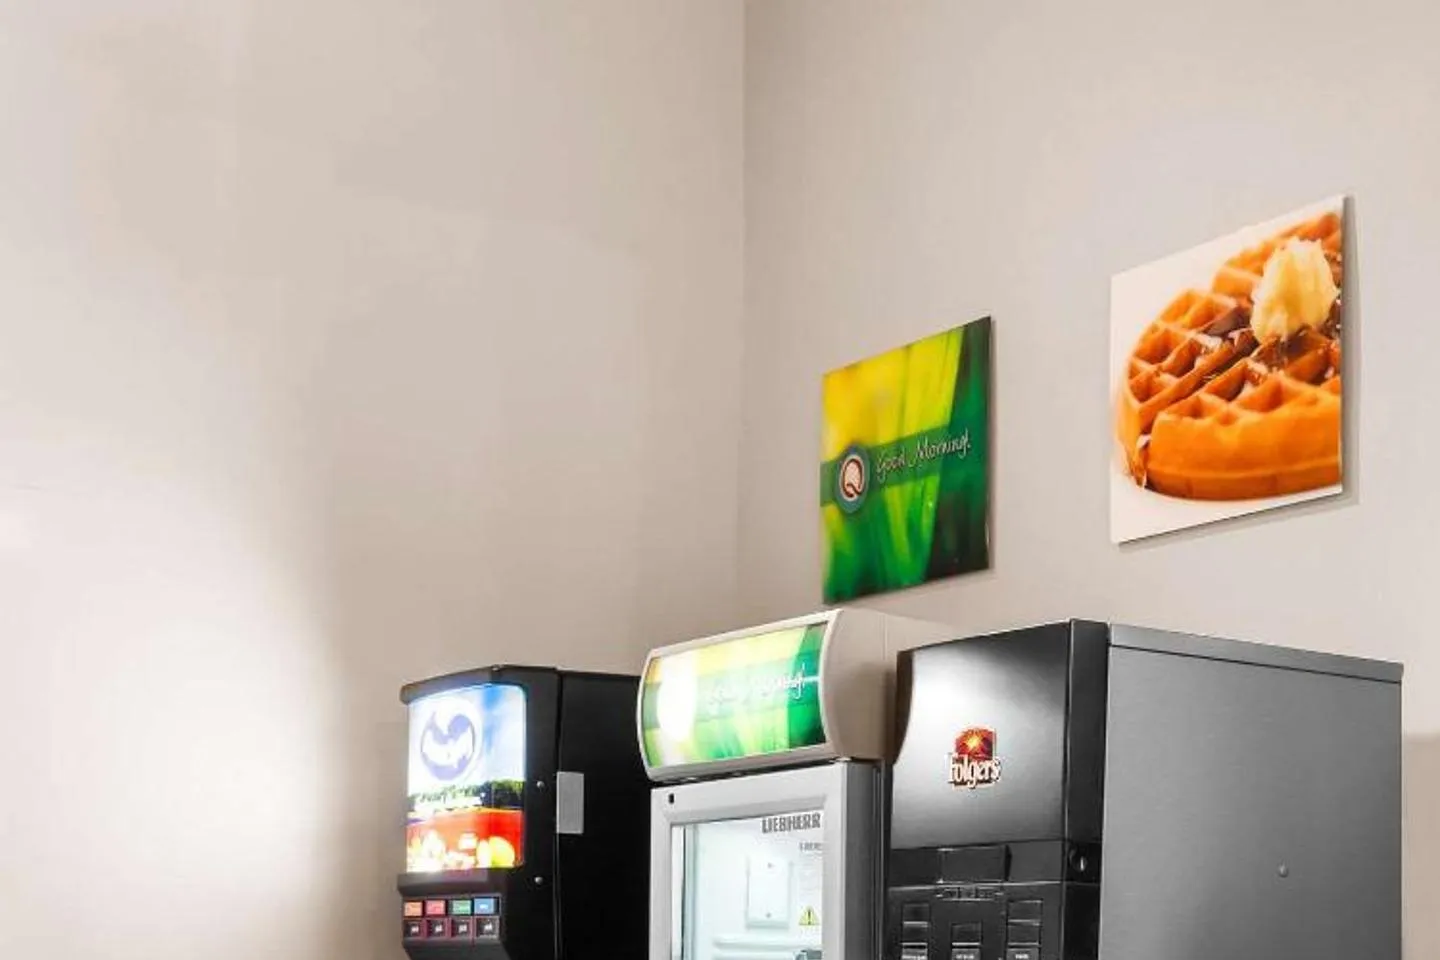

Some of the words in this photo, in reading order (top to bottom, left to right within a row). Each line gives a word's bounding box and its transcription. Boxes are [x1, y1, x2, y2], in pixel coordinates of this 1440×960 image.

[841, 457, 863, 499] Q
[876, 446, 906, 484] Good
[950, 753, 1001, 789] Folgers
[761, 812, 822, 834] LIEBHERR
